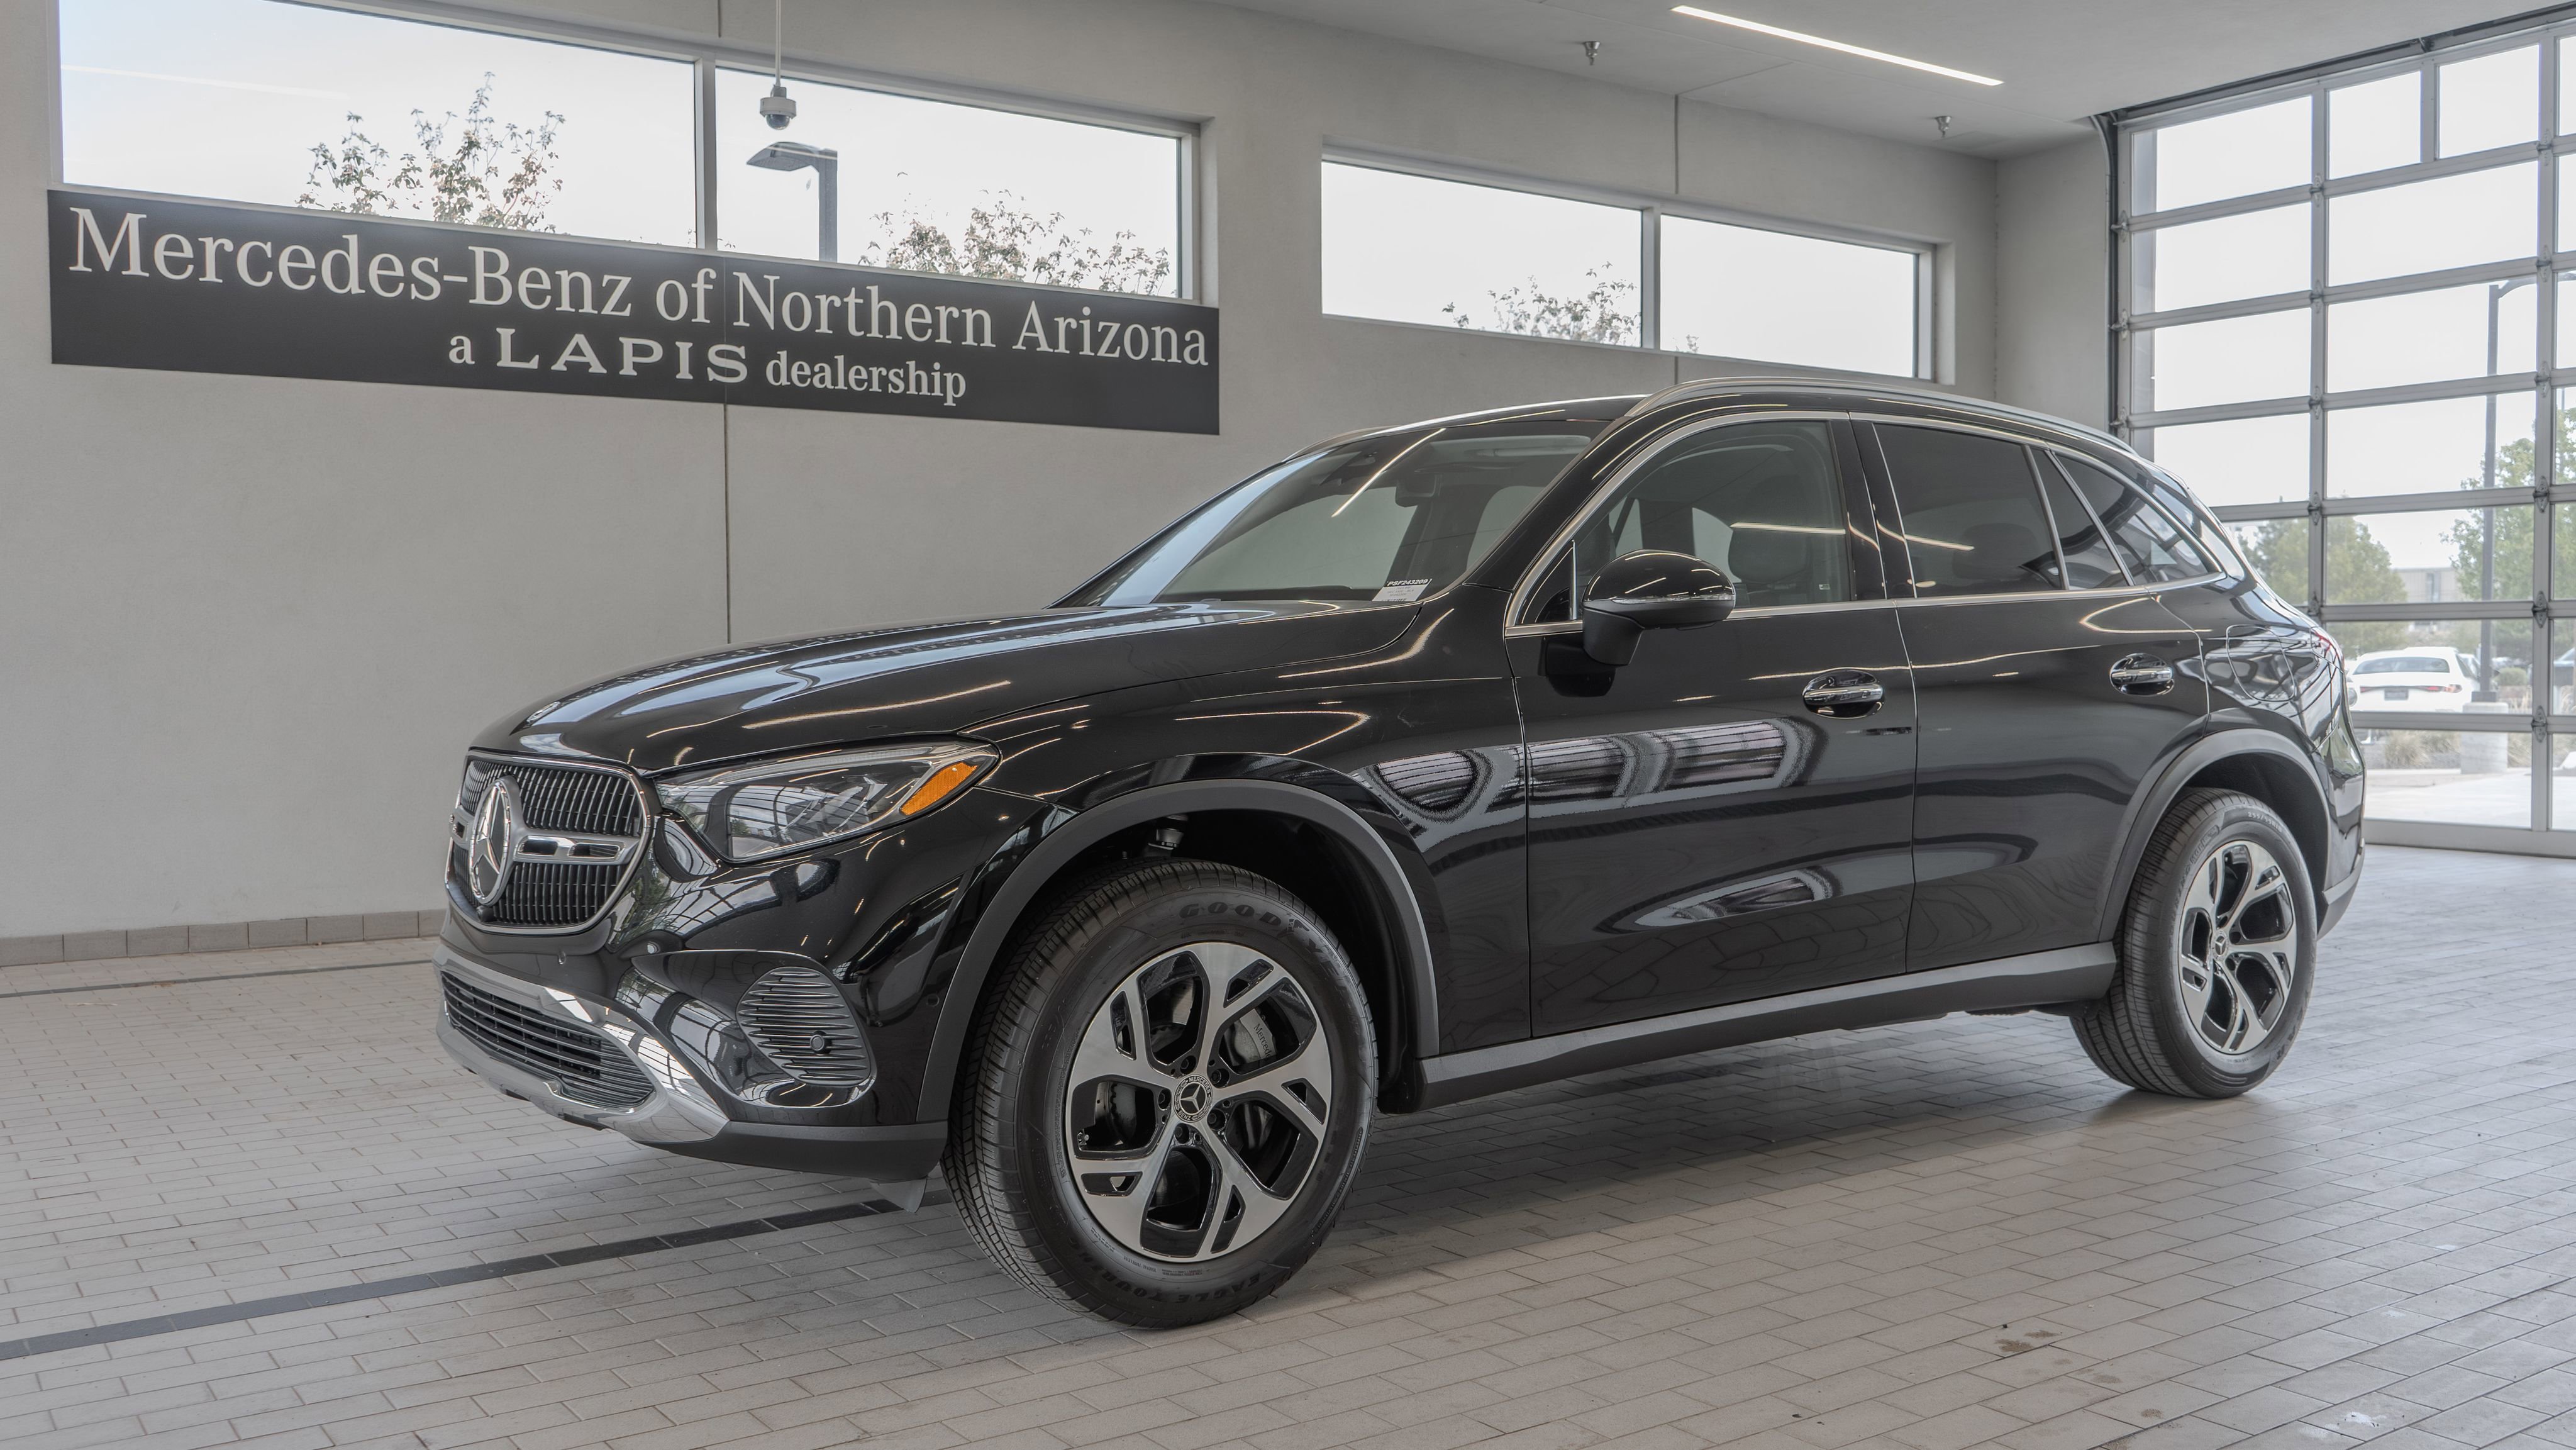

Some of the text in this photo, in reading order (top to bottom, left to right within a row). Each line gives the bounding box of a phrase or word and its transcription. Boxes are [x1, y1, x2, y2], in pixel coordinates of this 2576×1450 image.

[69, 207, 1208, 365] Mercedes-Benz of Northern Arizona
[448, 327, 966, 406] a LAPIS dealership
[1189, 1076, 1211, 1094] MERCEDES
[1178, 1110, 1192, 1120] BENZ
